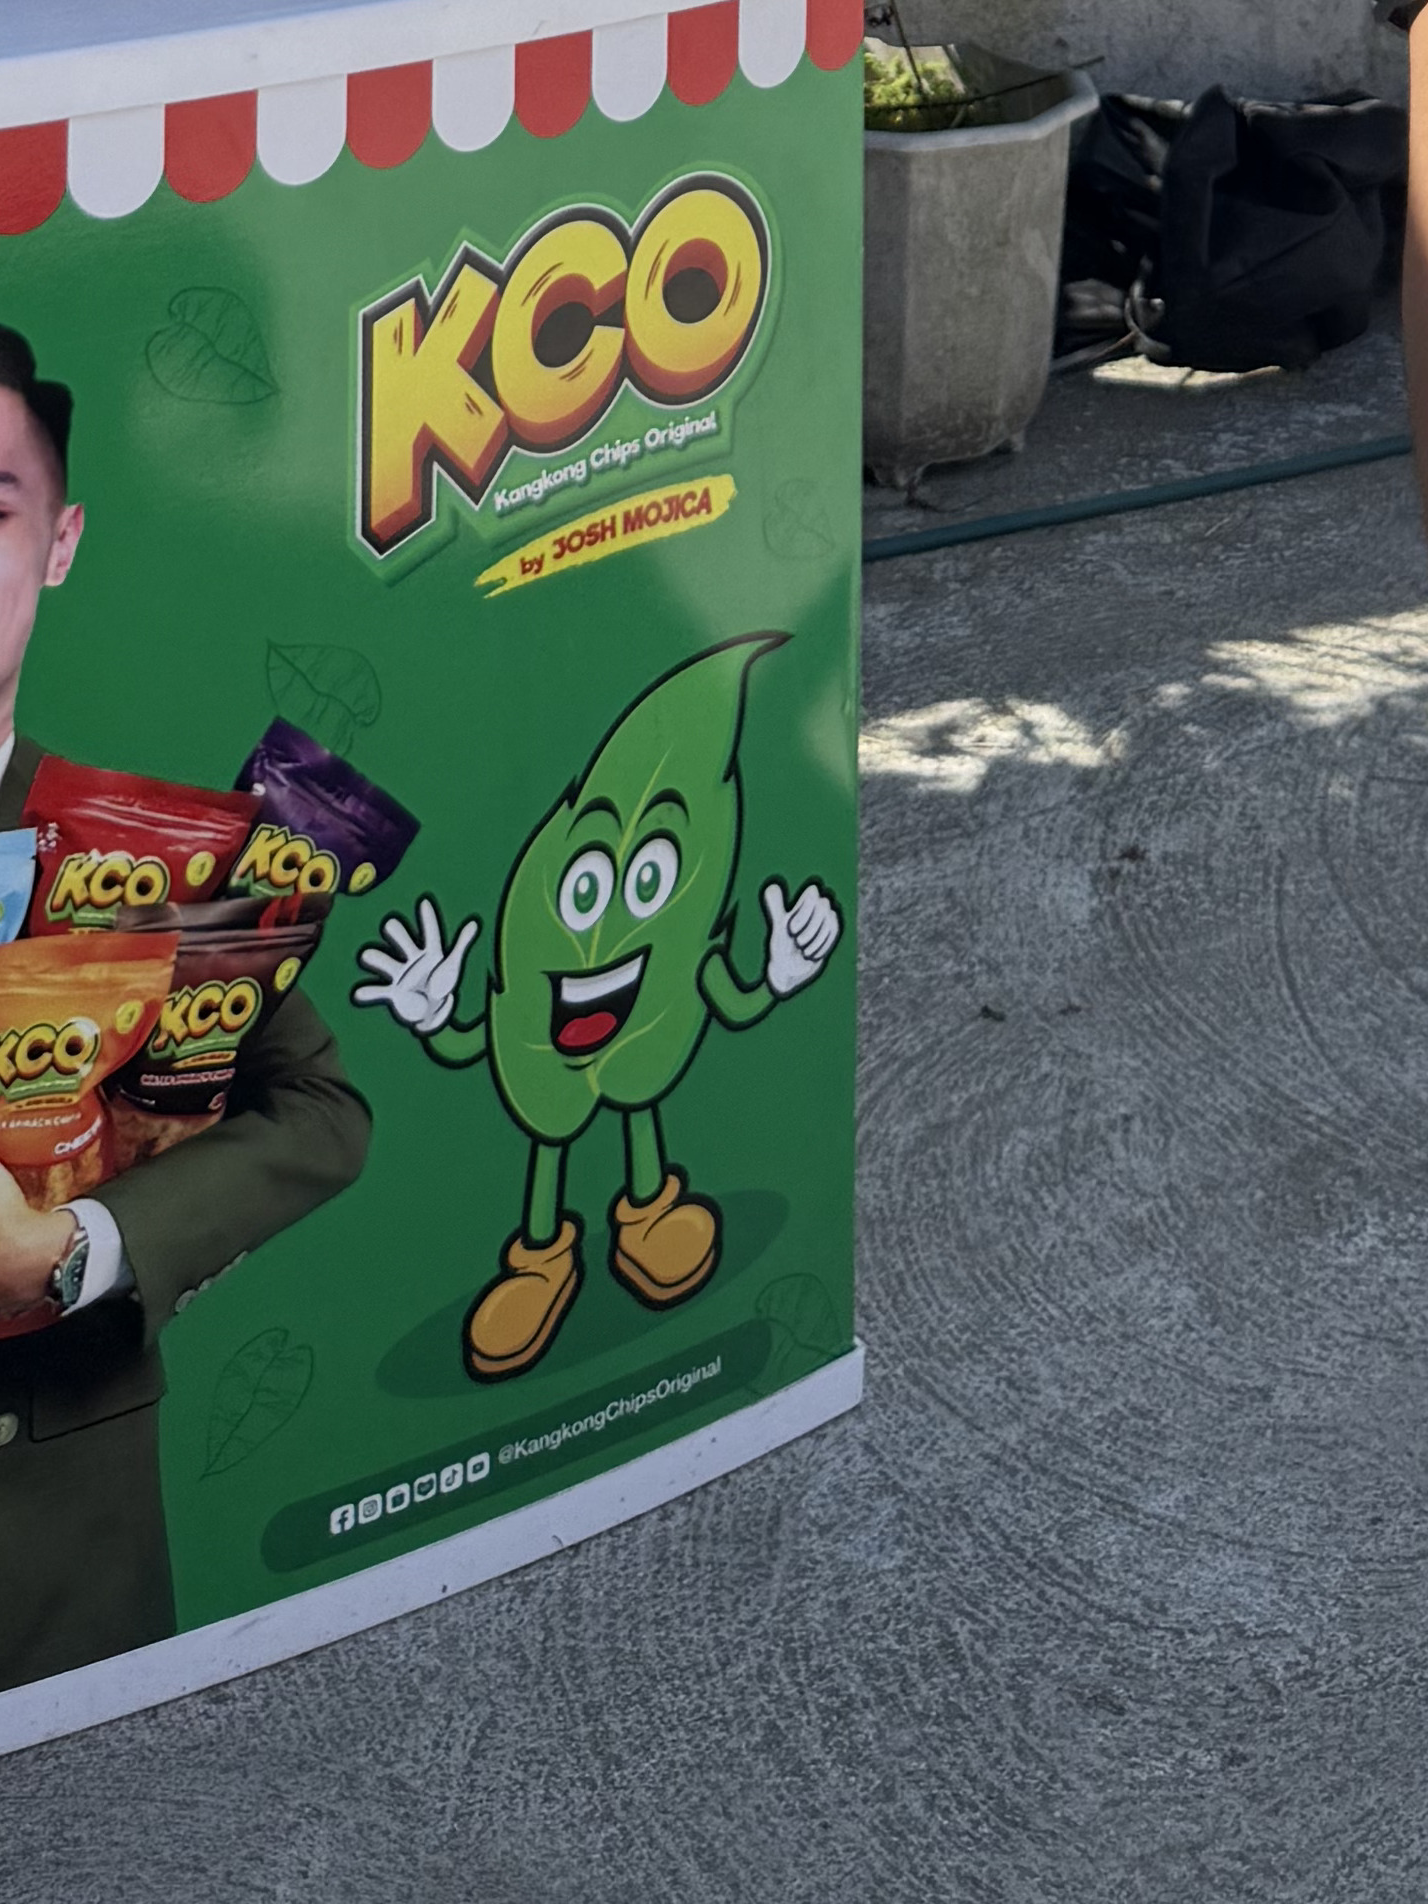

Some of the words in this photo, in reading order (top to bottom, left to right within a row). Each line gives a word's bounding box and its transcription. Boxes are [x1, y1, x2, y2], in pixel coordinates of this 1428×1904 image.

[364, 177, 767, 552] KCO
[494, 456, 586, 512] Kangkong
[590, 439, 640, 472] Chips
[645, 411, 717, 452] Original
[520, 554, 545, 577] by
[551, 521, 617, 561] JOSH
[623, 488, 713, 536] MOJICA
[51, 851, 169, 912] KCO
[235, 825, 340, 894] KCO
[152, 980, 257, 1050] KCO
[497, 1355, 723, 1465] @KangkongChipsOriginal
